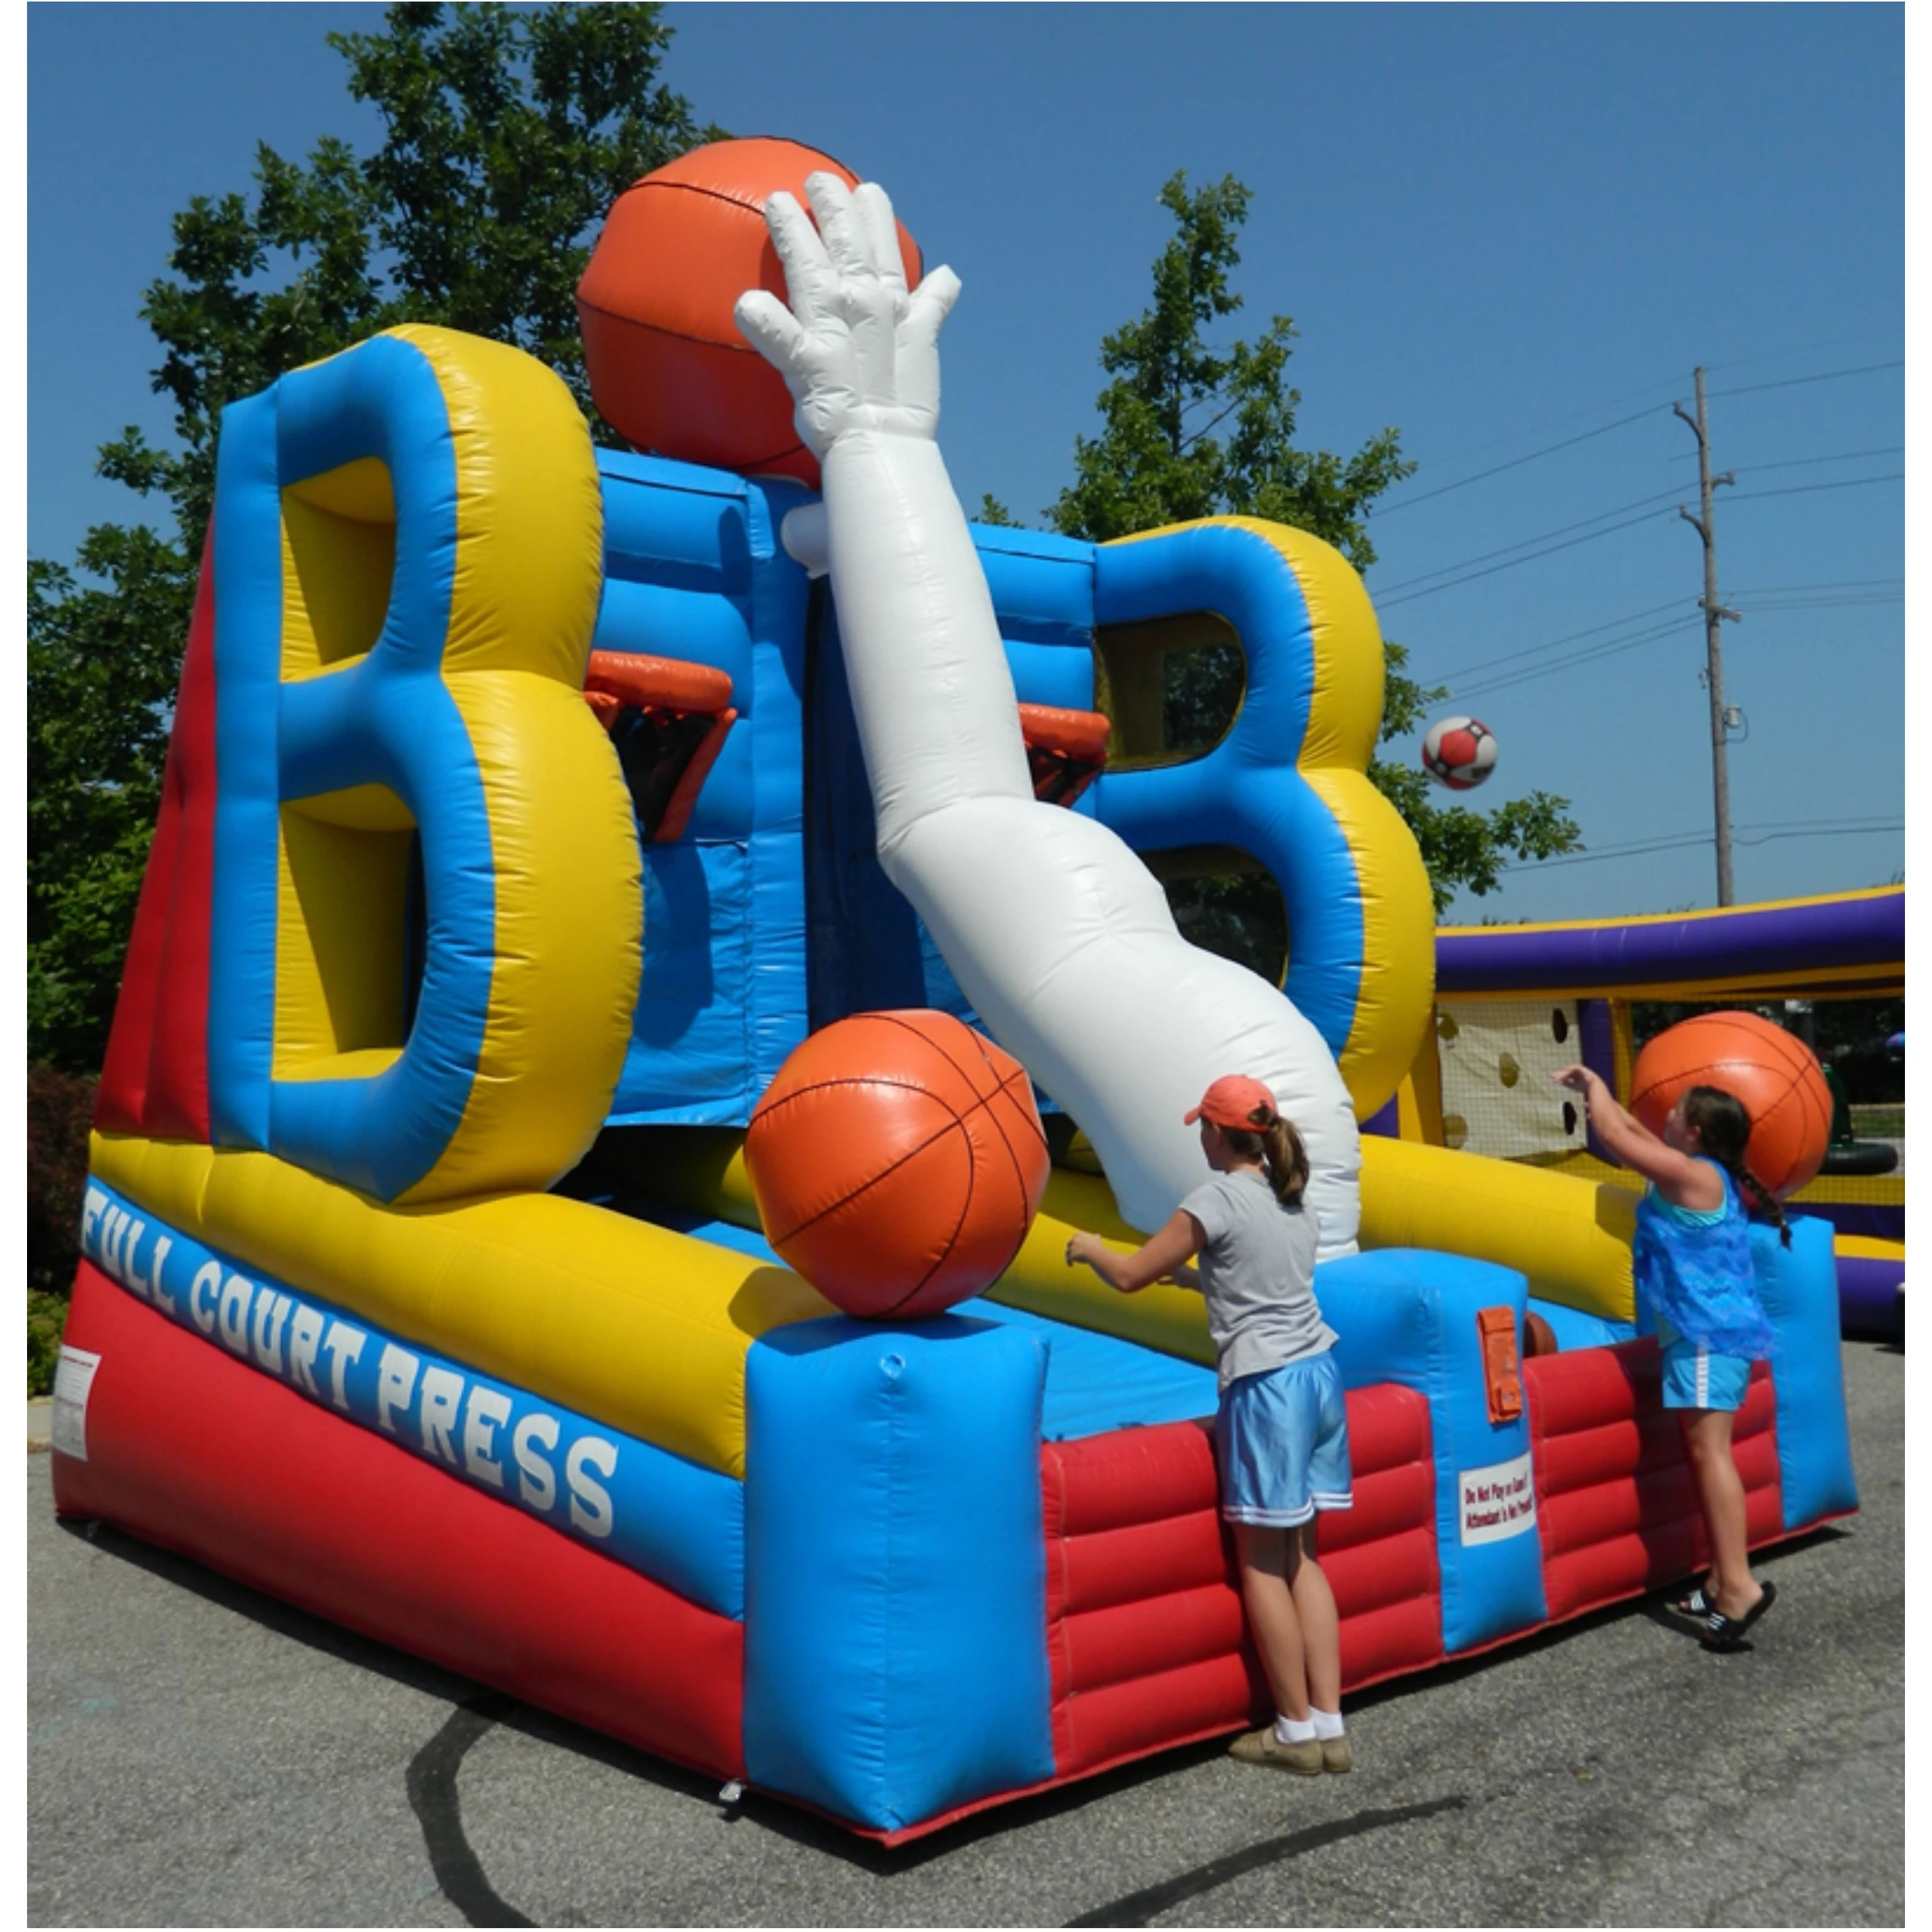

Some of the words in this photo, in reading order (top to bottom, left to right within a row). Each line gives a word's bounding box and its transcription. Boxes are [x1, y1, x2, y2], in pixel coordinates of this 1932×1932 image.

[80, 1185, 175, 1314] FULL
[190, 1260, 367, 1411] COURT
[378, 1343, 619, 1538] PRESS
